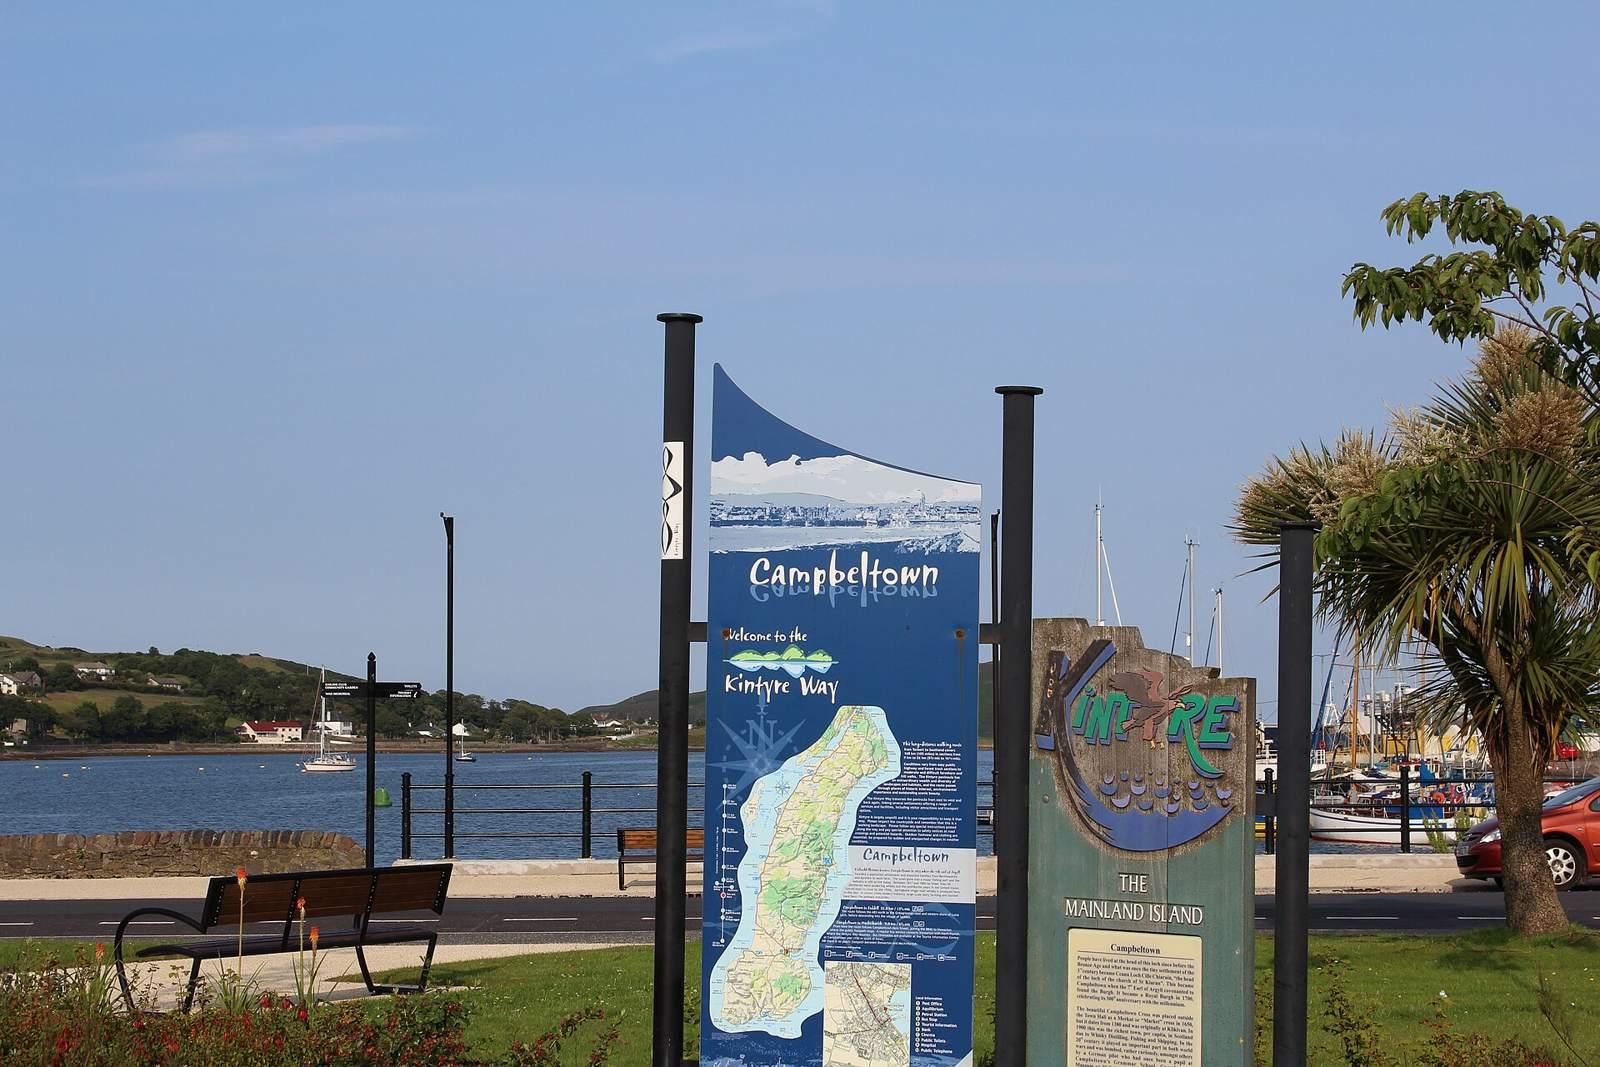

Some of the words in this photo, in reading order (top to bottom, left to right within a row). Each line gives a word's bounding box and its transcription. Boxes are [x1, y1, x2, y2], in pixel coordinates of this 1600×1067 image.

[750, 550, 938, 596] Campbeltown
[774, 630, 786, 642] to
[788, 626, 808, 643] the
[725, 674, 790, 703] Kintyre
[800, 676, 839, 703] Way
[863, 847, 949, 865] Campbeltown
[1120, 874, 1148, 893] THE
[1065, 899, 1145, 921] MAINLAND
[1149, 903, 1203, 925] ISLAND
[1110, 944, 1161, 955] Campbeltown
